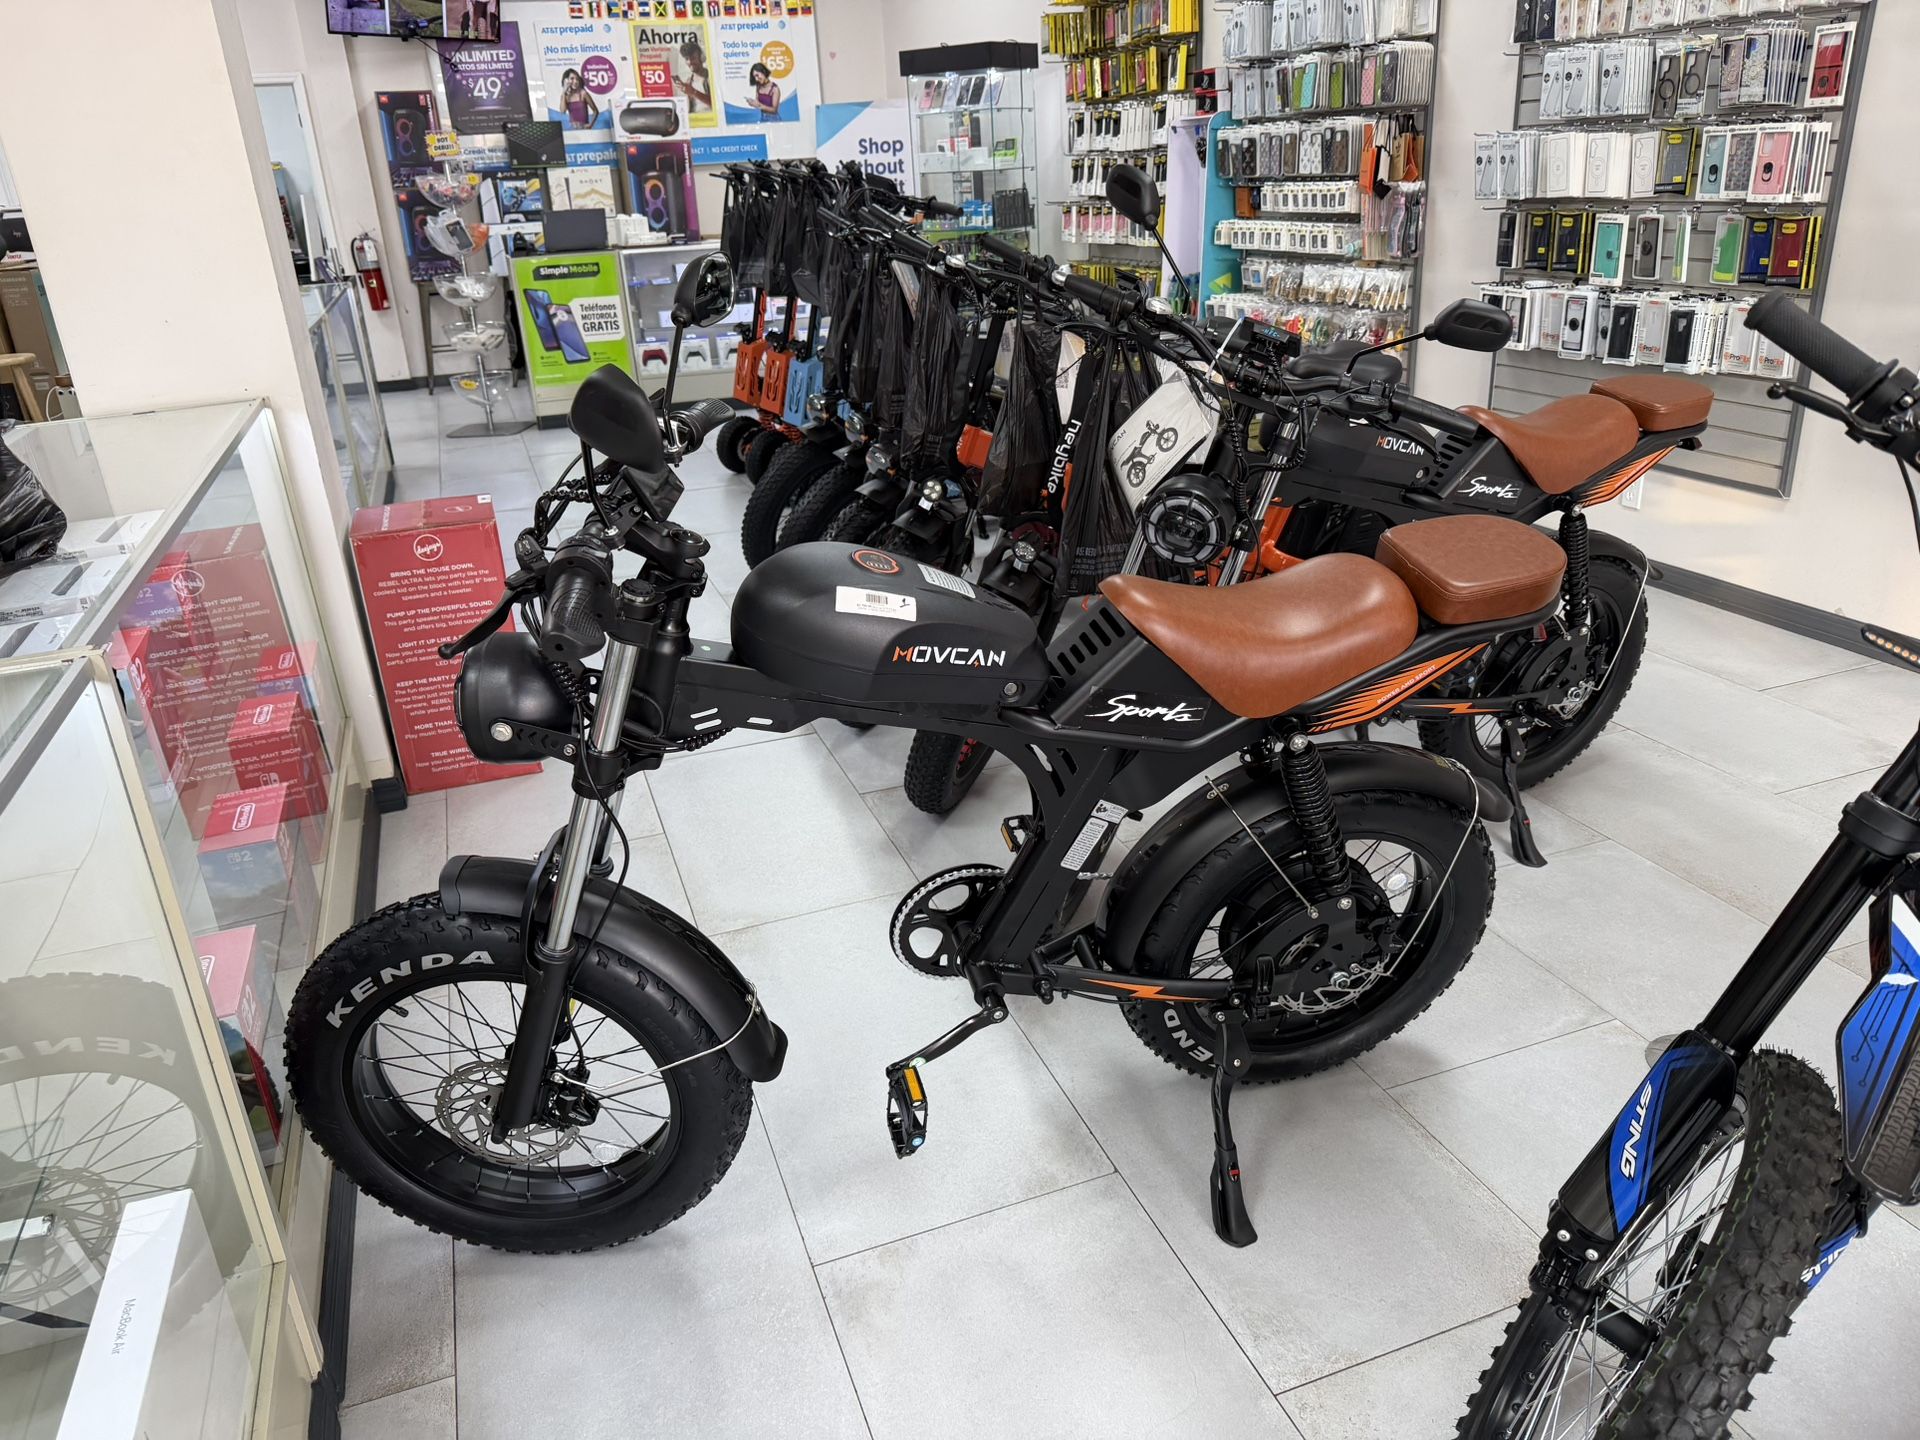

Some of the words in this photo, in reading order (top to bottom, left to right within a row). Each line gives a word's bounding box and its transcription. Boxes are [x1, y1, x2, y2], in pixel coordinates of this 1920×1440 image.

[560, 24, 593, 36] prepaid
[737, 21, 769, 32] prepaid
[639, 28, 699, 45] Ahorra
[543, 45, 559, 56] ¡No
[560, 44, 579, 53] más
[580, 43, 612, 53] límites!
[722, 41, 740, 49] Todo
[741, 40, 748, 48] lo
[723, 51, 750, 60] quieres
[467, 77, 501, 100] $49
[858, 137, 904, 157] Shop
[540, 266, 569, 276] Simple
[569, 264, 599, 273] Mobile
[580, 303, 616, 313] Teléfonos
[581, 312, 618, 321] MOTOROLA
[582, 320, 620, 333] GRATIS
[1375, 435, 1425, 456] MOVCAN
[1047, 419, 1082, 494] heybike
[1457, 476, 1520, 499] Sports
[390, 570, 412, 578] BRING
[426, 565, 450, 573] HOUSE
[451, 562, 475, 570] DOWN.
[401, 576, 423, 584] ULTRA
[449, 571, 466, 579] party
[373, 589, 396, 597] coolest
[401, 593, 429, 601] speakers
[431, 603, 468, 612] POWERFUL
[469, 599, 494, 608] SOUND.
[398, 618, 415, 626] party
[416, 614, 440, 623] speaker
[441, 612, 455, 620] truly
[456, 610, 474, 618] packs
[398, 640, 417, 648] LIGHT
[892, 645, 1007, 668] MOVCAN
[396, 680, 414, 688] KEEP
[428, 675, 450, 683] PARTY
[1377, 687, 1400, 704] POWER
[1401, 679, 1415, 690] AND
[1414, 665, 1437, 680] SPORT
[431, 697, 452, 705] REBEL
[1084, 694, 1204, 723] Sports
[430, 750, 448, 758] TRUE
[431, 764, 459, 773] Surround
[460, 760, 479, 768] Sound
[326, 950, 495, 1029] KENDA
[1620, 1080, 1652, 1178] STING
[115, 1298, 137, 1342] MacBook
[112, 1342, 125, 1355] Air
